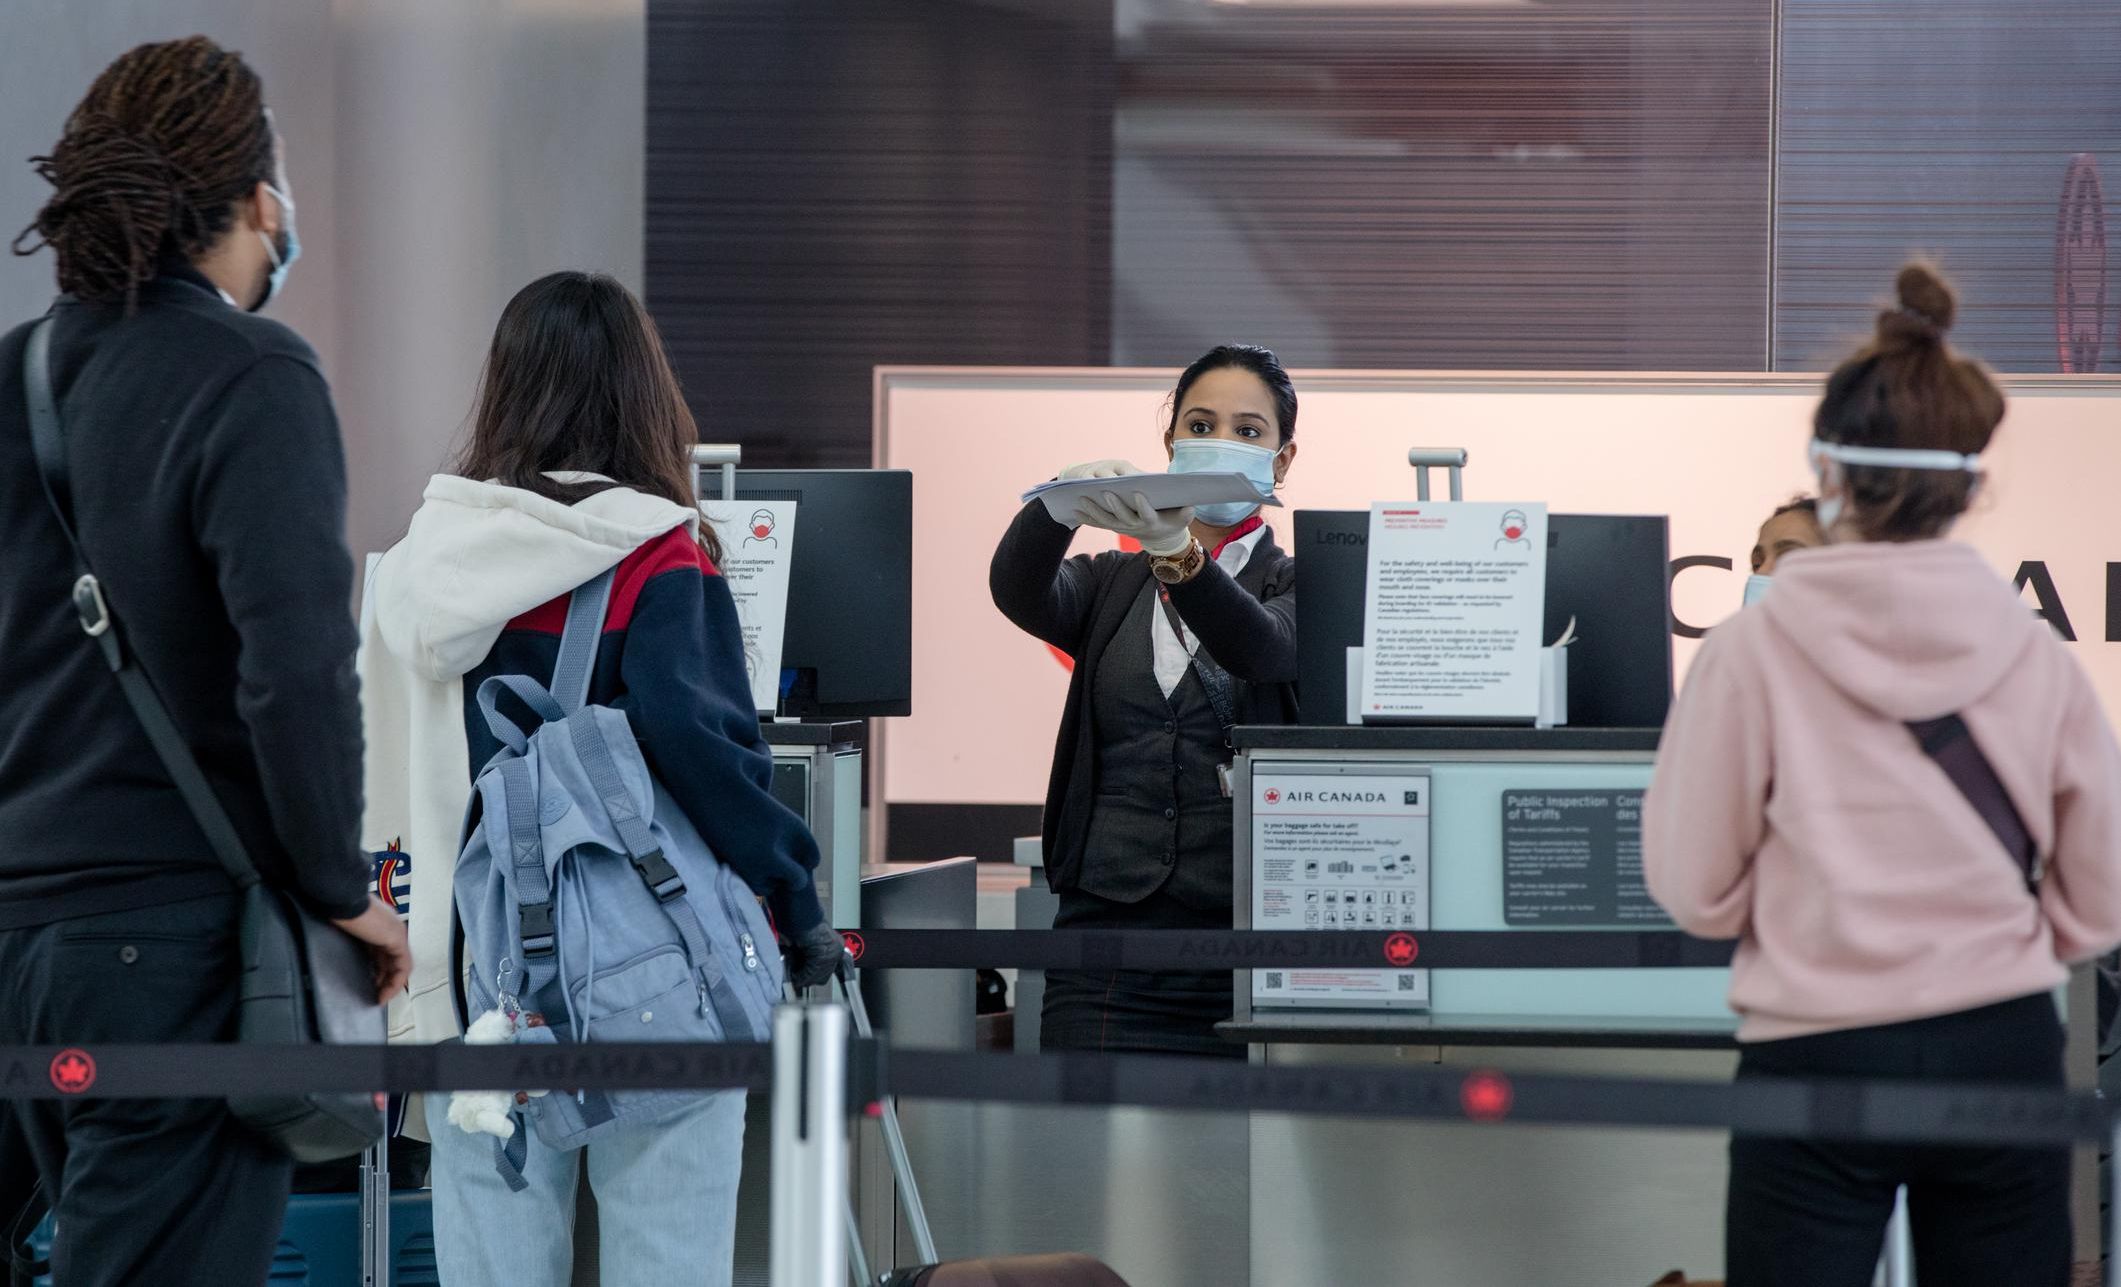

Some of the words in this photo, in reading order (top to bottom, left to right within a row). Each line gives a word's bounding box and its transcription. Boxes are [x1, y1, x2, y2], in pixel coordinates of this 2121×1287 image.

[1316, 529, 1367, 545] Lenov
[1286, 792, 1314, 802] AIR
[1318, 792, 1386, 802] CANADA
[1508, 796, 1545, 807] Public
[1546, 796, 1609, 809] Inspection
[1508, 809, 1520, 820] of
[1523, 809, 1562, 820] Tariffs
[1616, 809, 1638, 820] des
